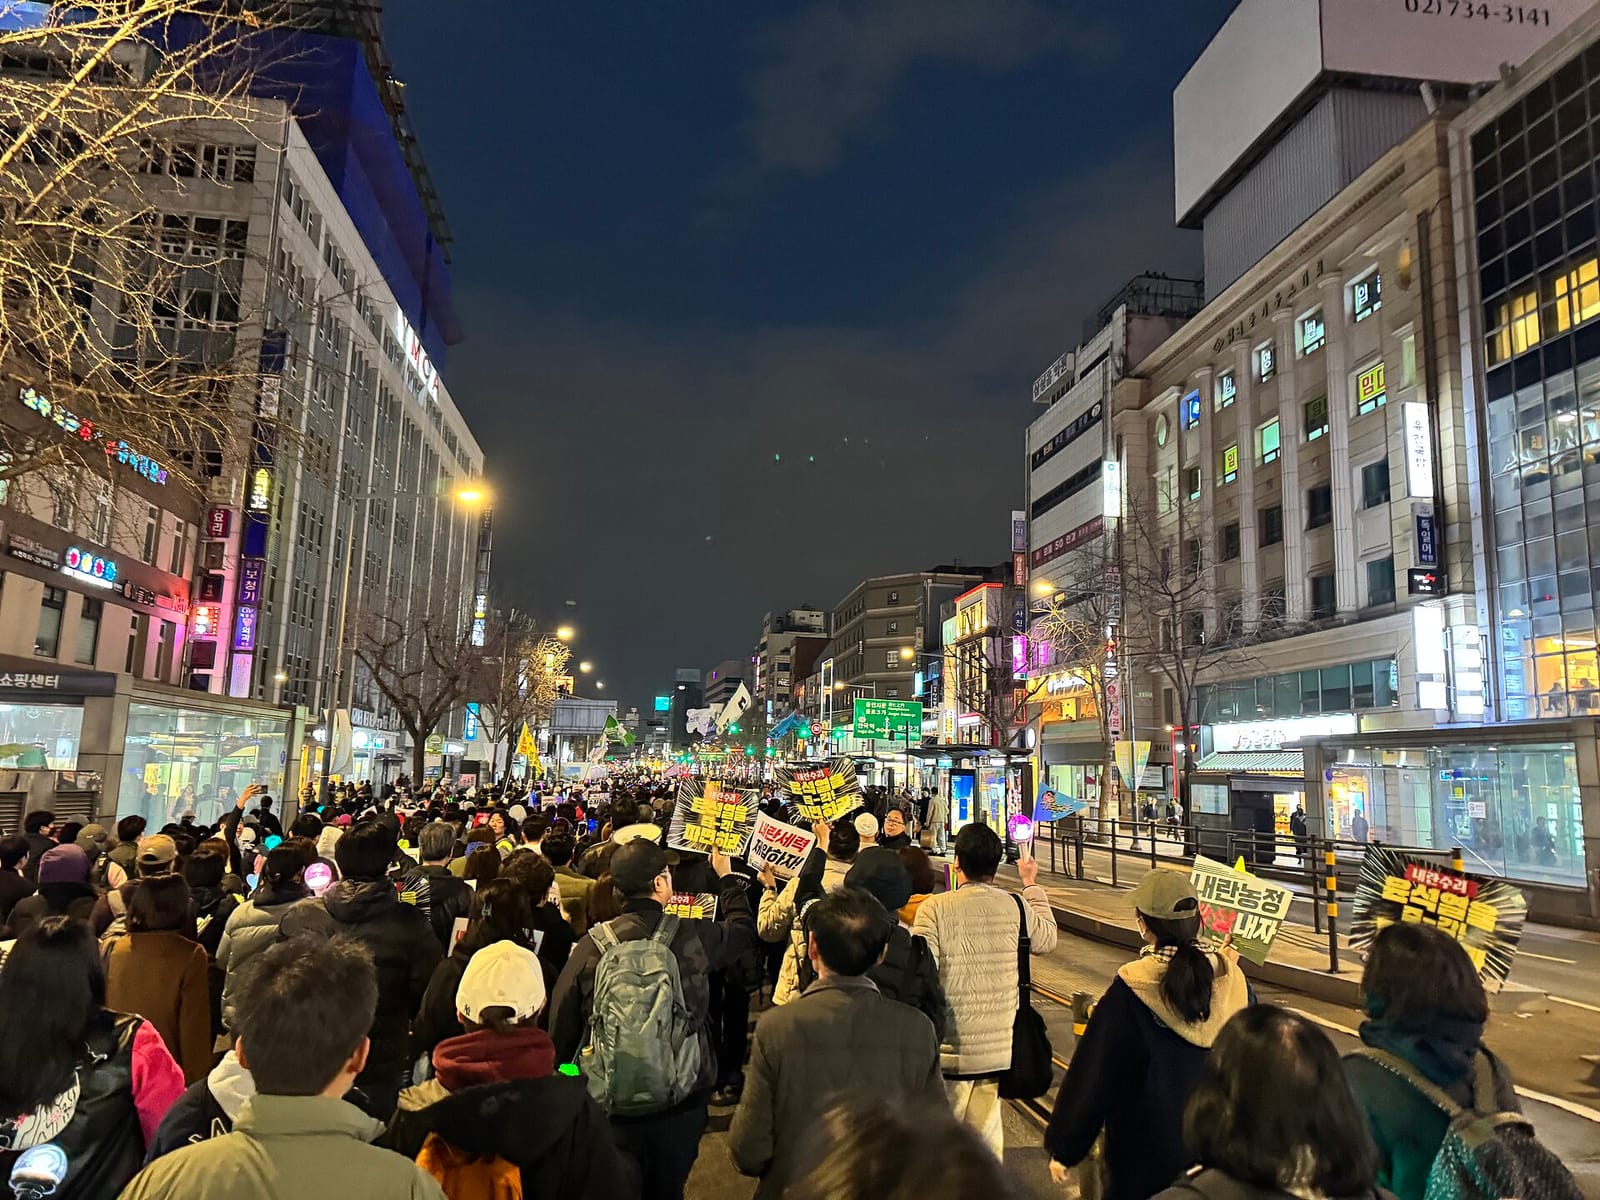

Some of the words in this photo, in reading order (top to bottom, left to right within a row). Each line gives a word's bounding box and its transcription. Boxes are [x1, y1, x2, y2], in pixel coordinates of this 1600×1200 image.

[1404, 0, 1550, 27] 02)734-3141
[212, 512, 224, 532] 요리
[1421, 519, 1432, 555] 독일어
[243, 569, 258, 601] 보청기
[0, 672, 60, 689] 쇼핑센터
[758, 820, 811, 854] 내란세력
[752, 839, 806, 871] 제압하자!
[1194, 873, 1286, 914] 내란농정
[1381, 875, 1500, 933] 윤석열을
